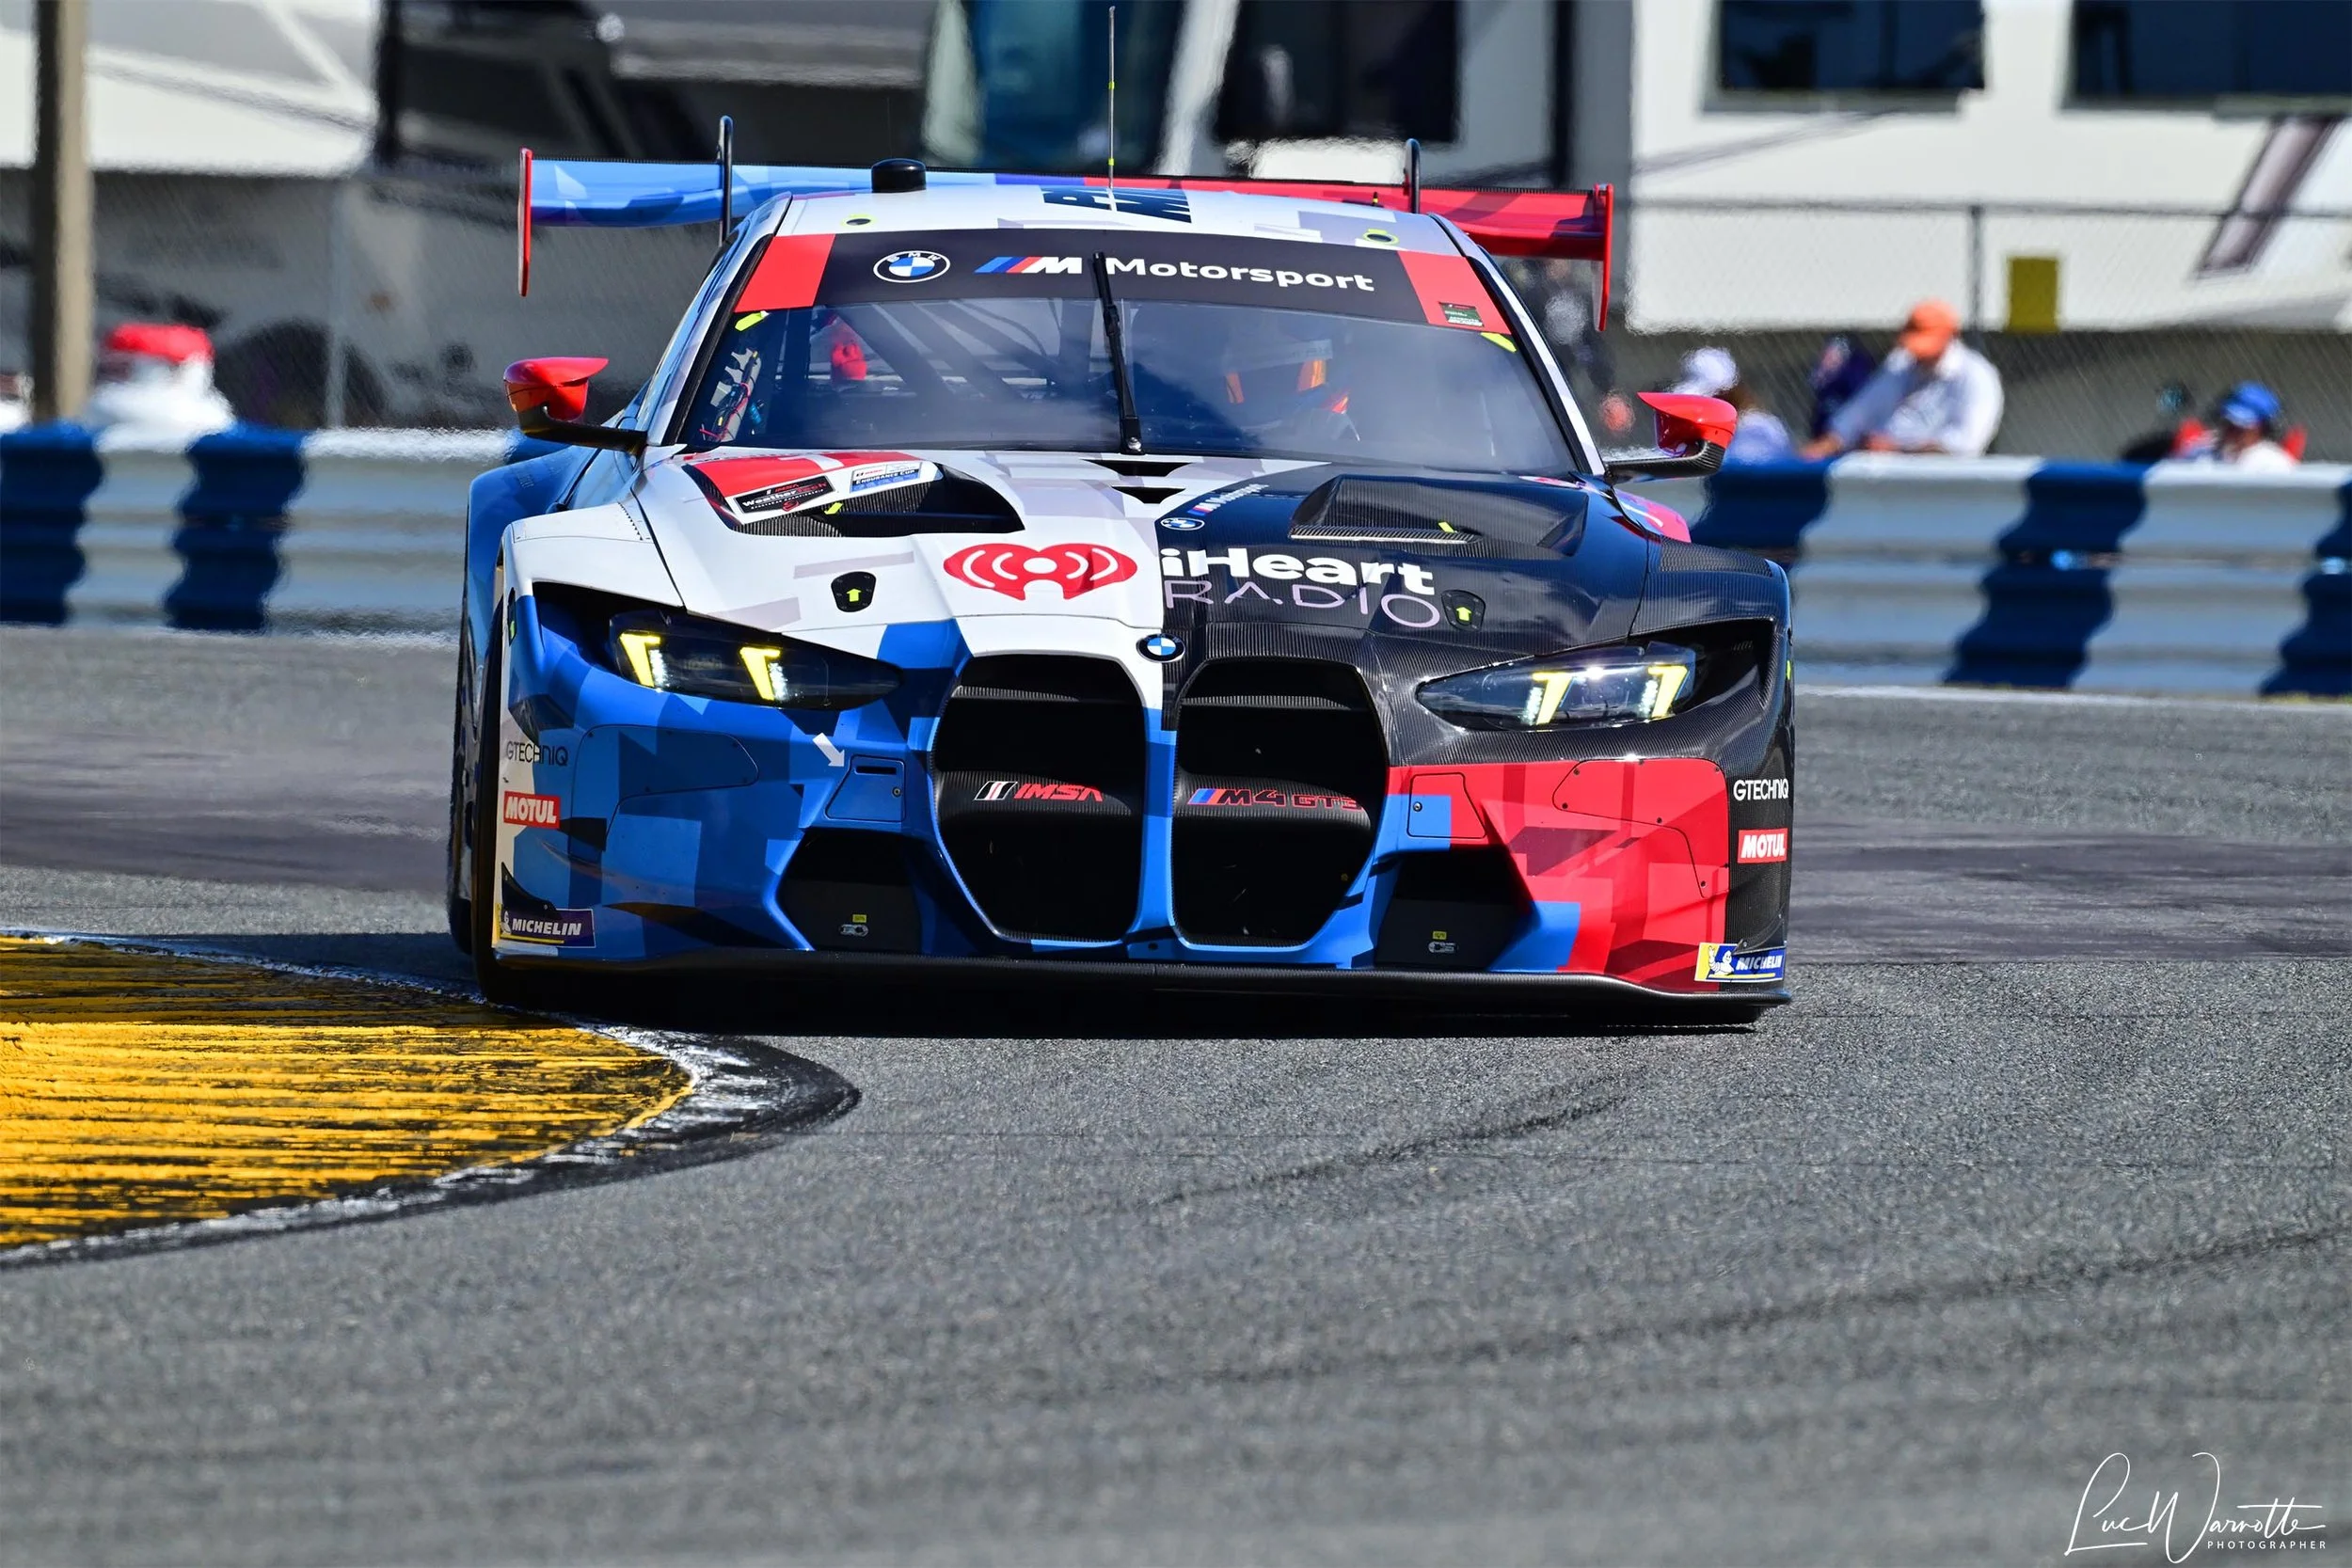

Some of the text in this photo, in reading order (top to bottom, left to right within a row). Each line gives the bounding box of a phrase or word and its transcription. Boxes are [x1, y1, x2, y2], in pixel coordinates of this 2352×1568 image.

[1020, 256, 1375, 292] M Motorsport
[855, 472, 898, 485] ENDURANCE
[1160, 547, 1436, 595] iHeart
[1164, 579, 1441, 628] RADIO
[505, 739, 568, 767] GTECHNIQ
[1013, 783, 1103, 802] IMSA
[1733, 778, 1788, 800] GTECHNIQ
[505, 796, 557, 824] MOTUL
[1740, 832, 1787, 859] MOTUL
[512, 918, 582, 936] MICHELIN
[1736, 954, 1784, 972] MICHELIN
